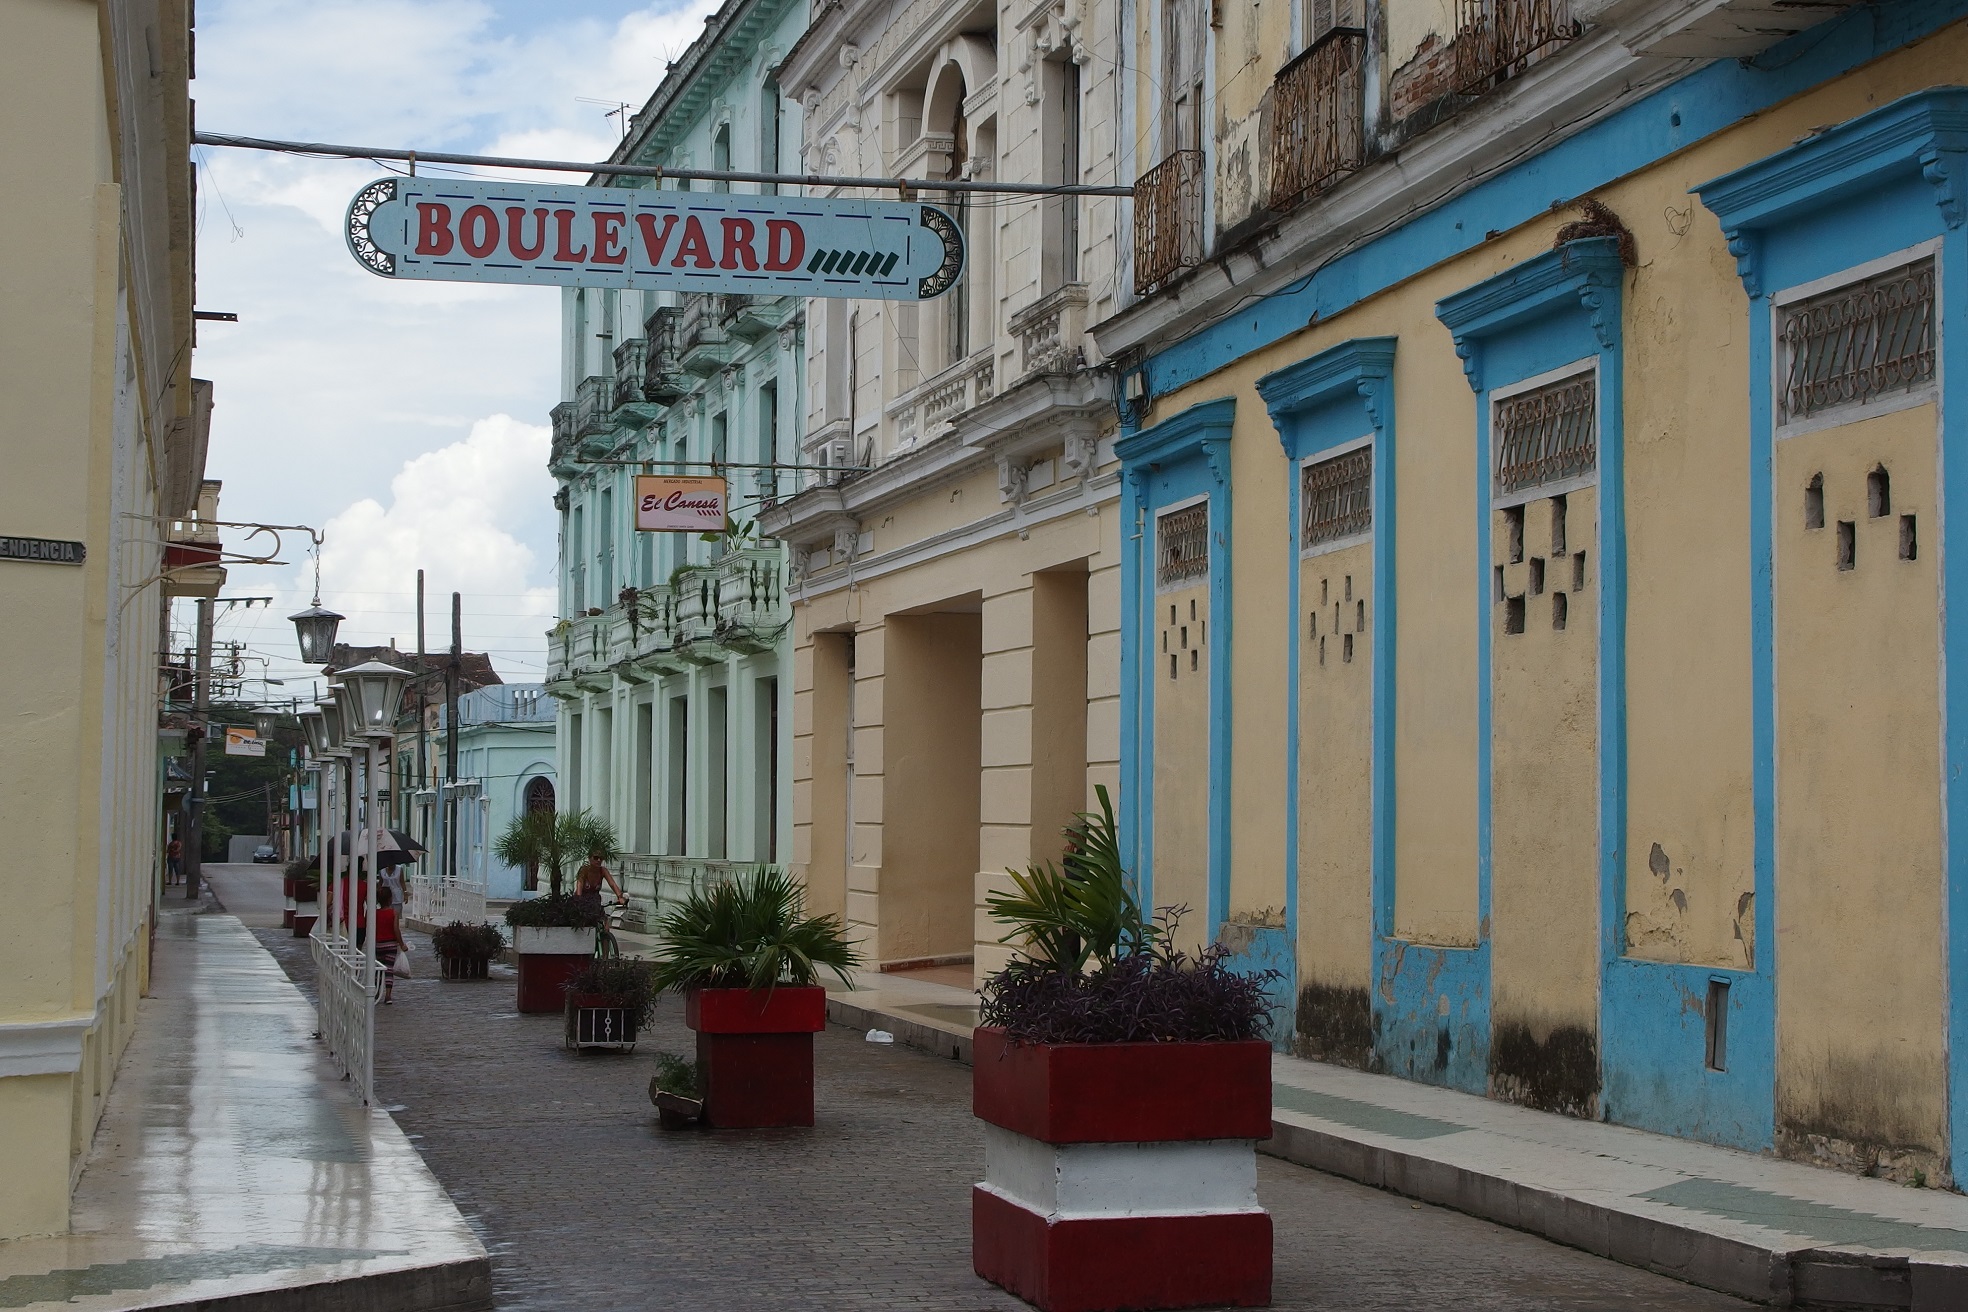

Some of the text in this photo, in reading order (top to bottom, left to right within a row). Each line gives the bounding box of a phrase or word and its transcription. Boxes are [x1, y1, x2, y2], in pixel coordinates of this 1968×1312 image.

[415, 202, 806, 272] BOULEVARD
[641, 491, 718, 511] El Canesú
[0, 539, 74, 559] ENDENCIA
